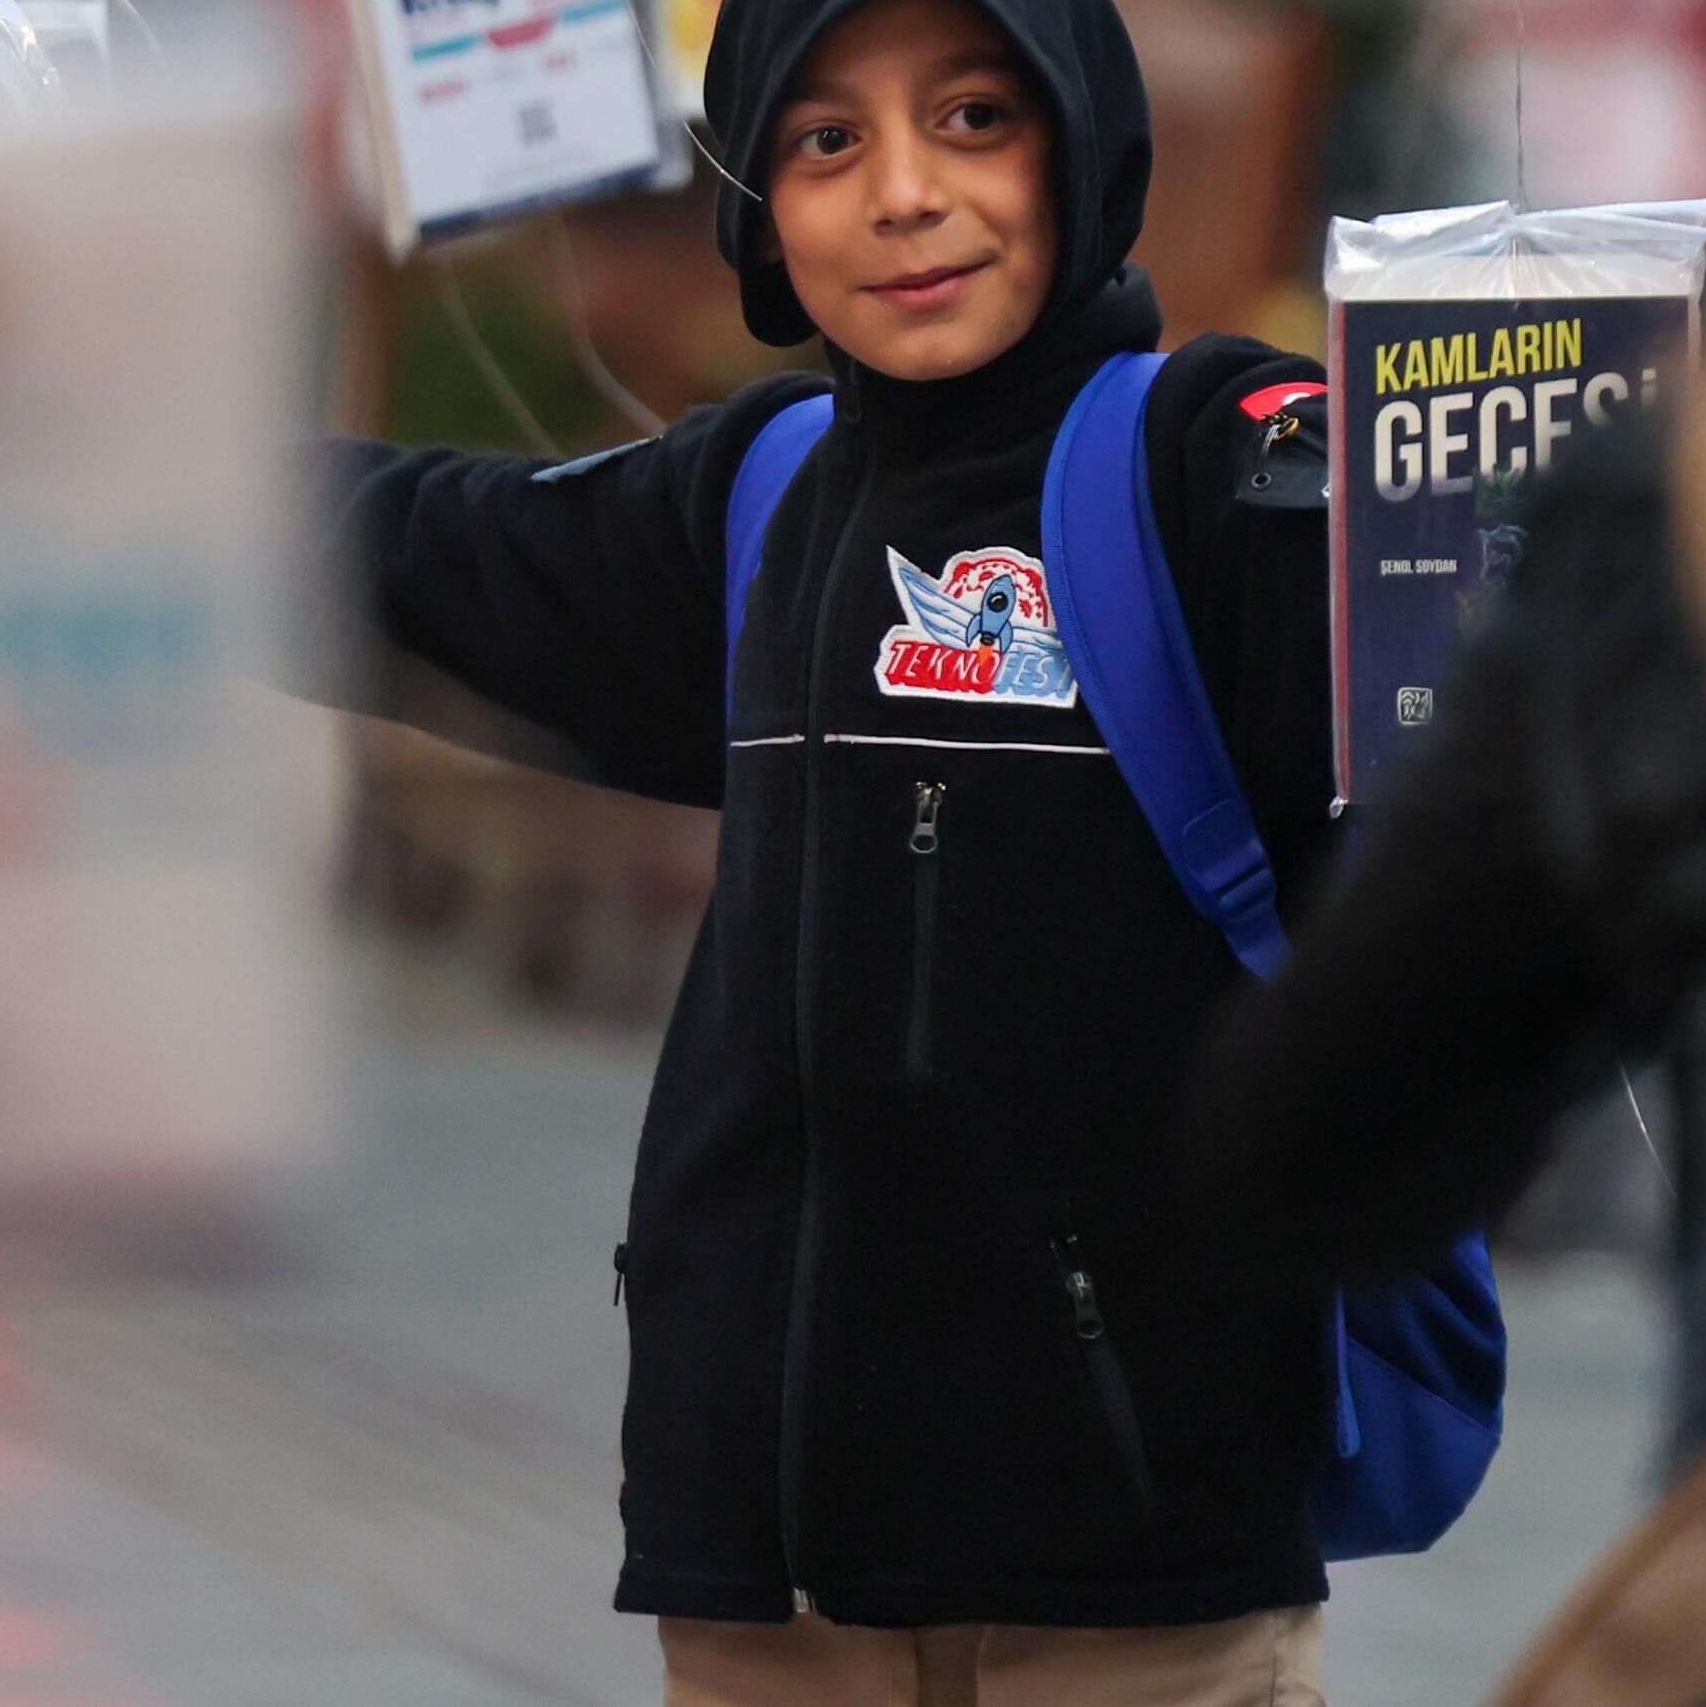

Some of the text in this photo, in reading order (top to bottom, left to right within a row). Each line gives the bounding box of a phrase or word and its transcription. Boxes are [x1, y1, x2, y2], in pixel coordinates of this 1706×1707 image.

[1375, 317, 1582, 395] KAMLARIN
[1380, 559, 1458, 577] ŞENOL SOYDAN
